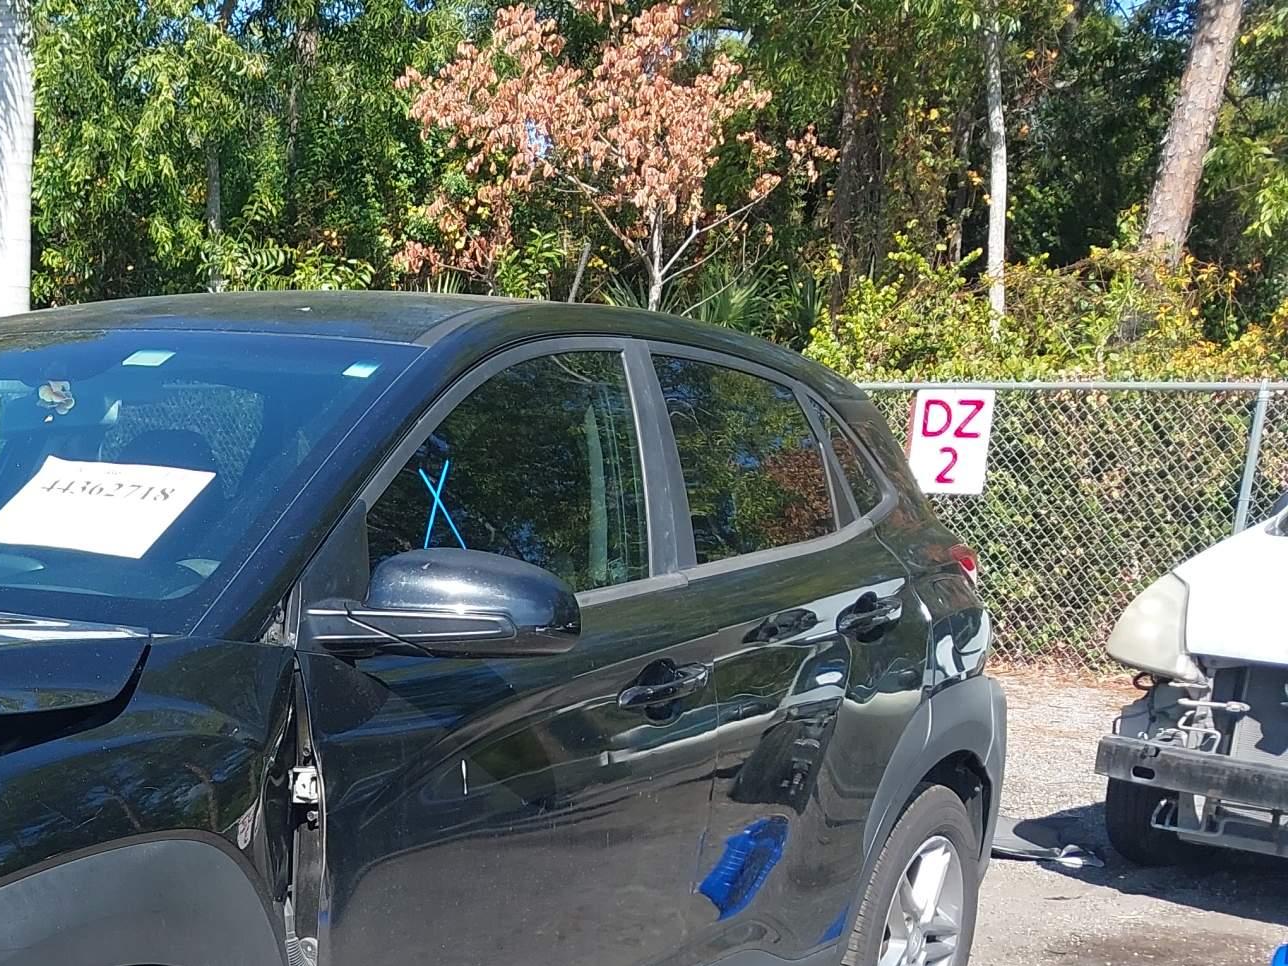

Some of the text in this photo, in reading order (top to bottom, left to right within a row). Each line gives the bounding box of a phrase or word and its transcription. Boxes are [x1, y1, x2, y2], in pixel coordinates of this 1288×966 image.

[922, 399, 985, 438] DZ
[935, 446, 958, 483] 2
[42, 480, 176, 501] 44362718
